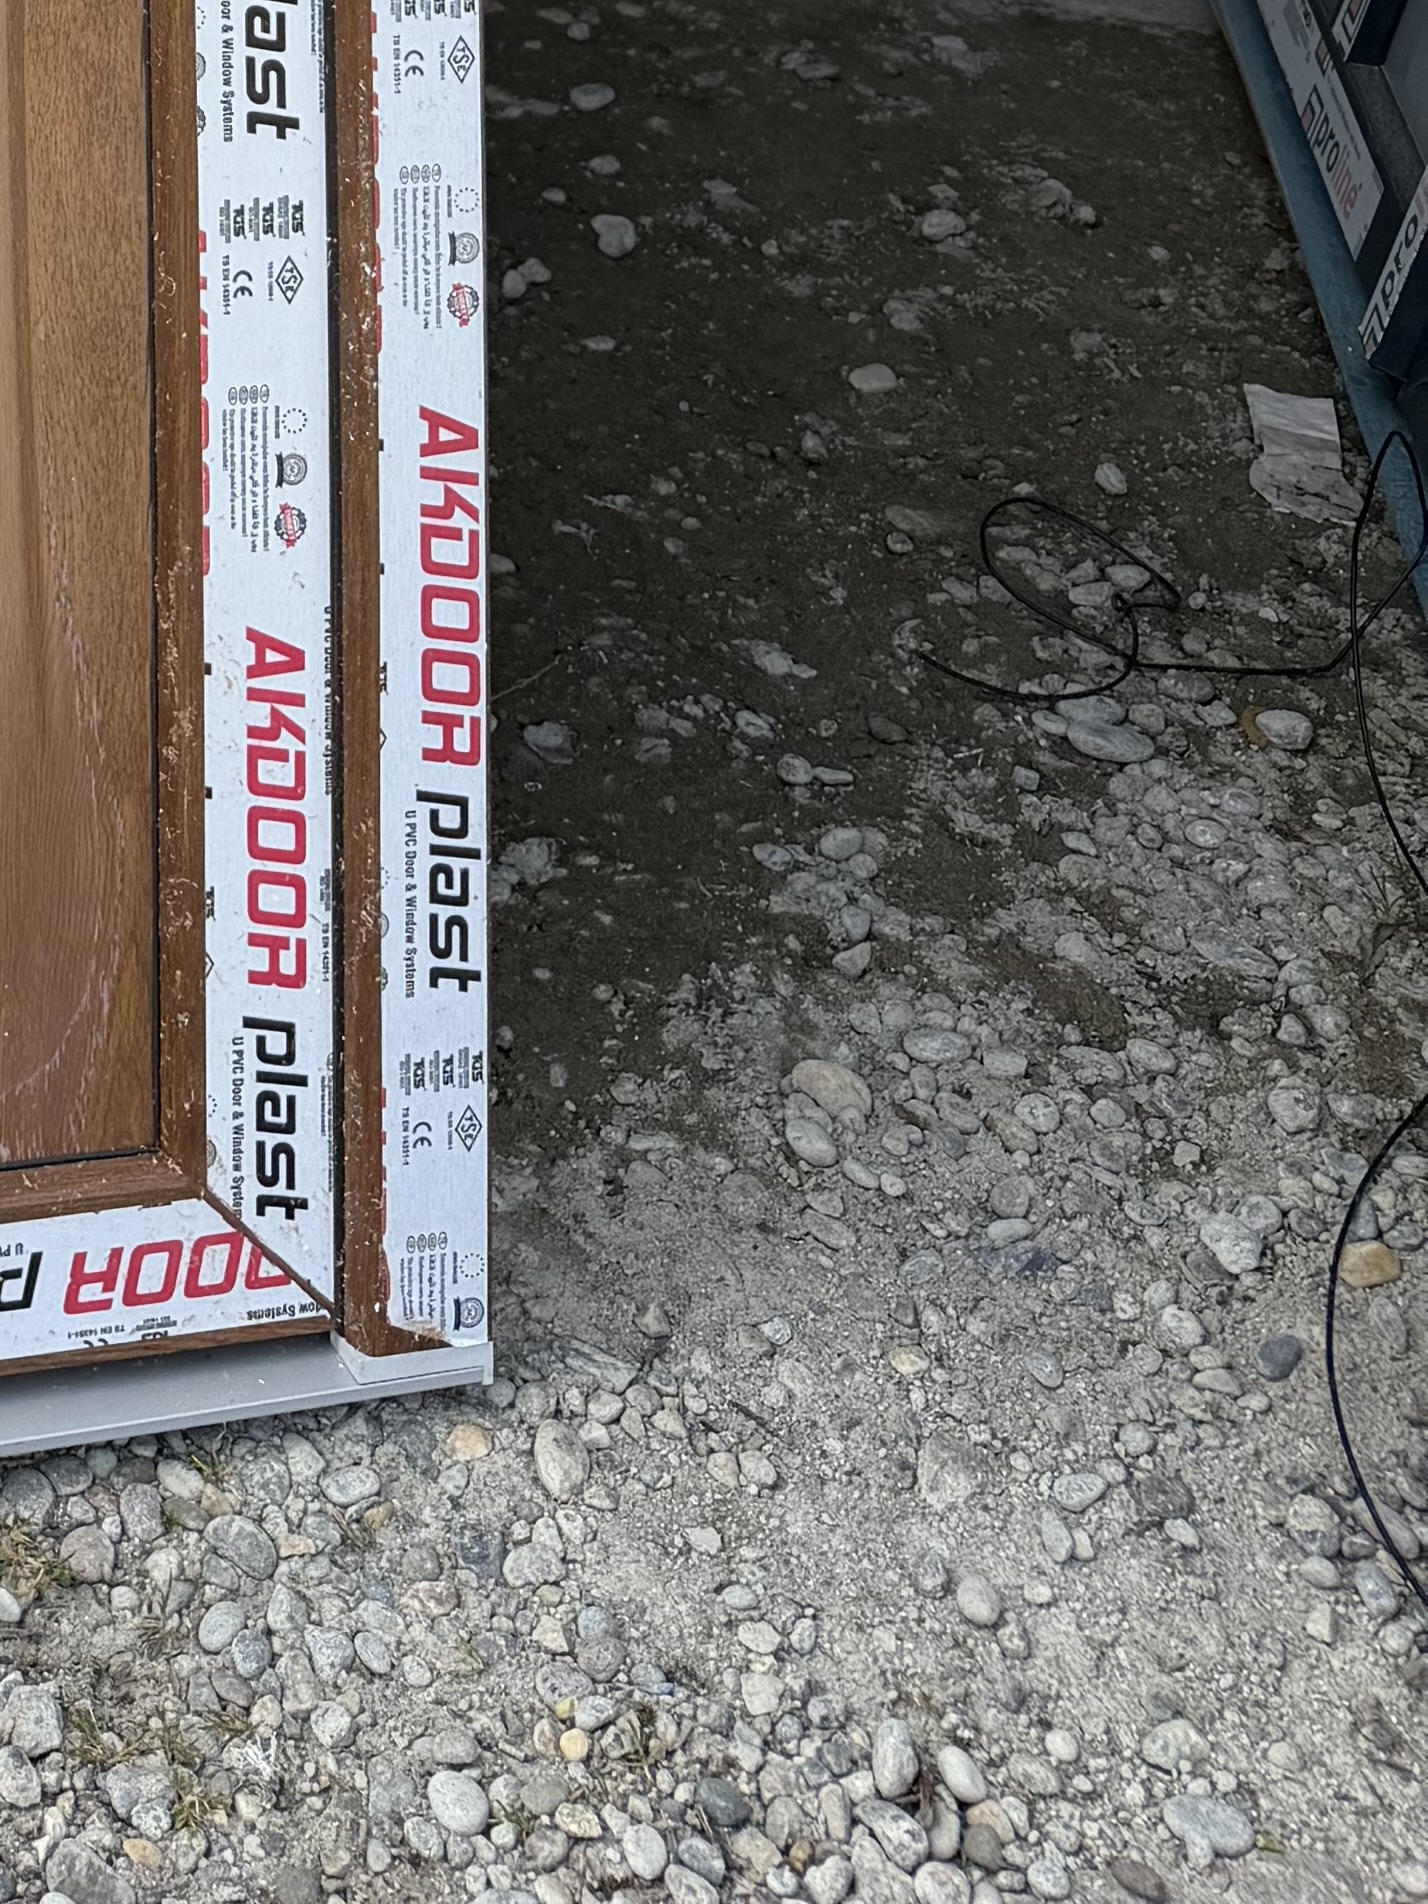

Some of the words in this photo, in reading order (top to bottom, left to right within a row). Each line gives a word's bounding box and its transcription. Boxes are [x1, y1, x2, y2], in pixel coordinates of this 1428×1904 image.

[221, 24, 234, 33] &
[221, 37, 234, 87] Window
[219, 90, 235, 143] Systems
[419, 407, 481, 767] AKDOOR
[245, 628, 307, 990] AKDOOR
[413, 788, 482, 993] plast
[239, 1015, 309, 1225] plast
[412, 1122, 432, 1148] CE
